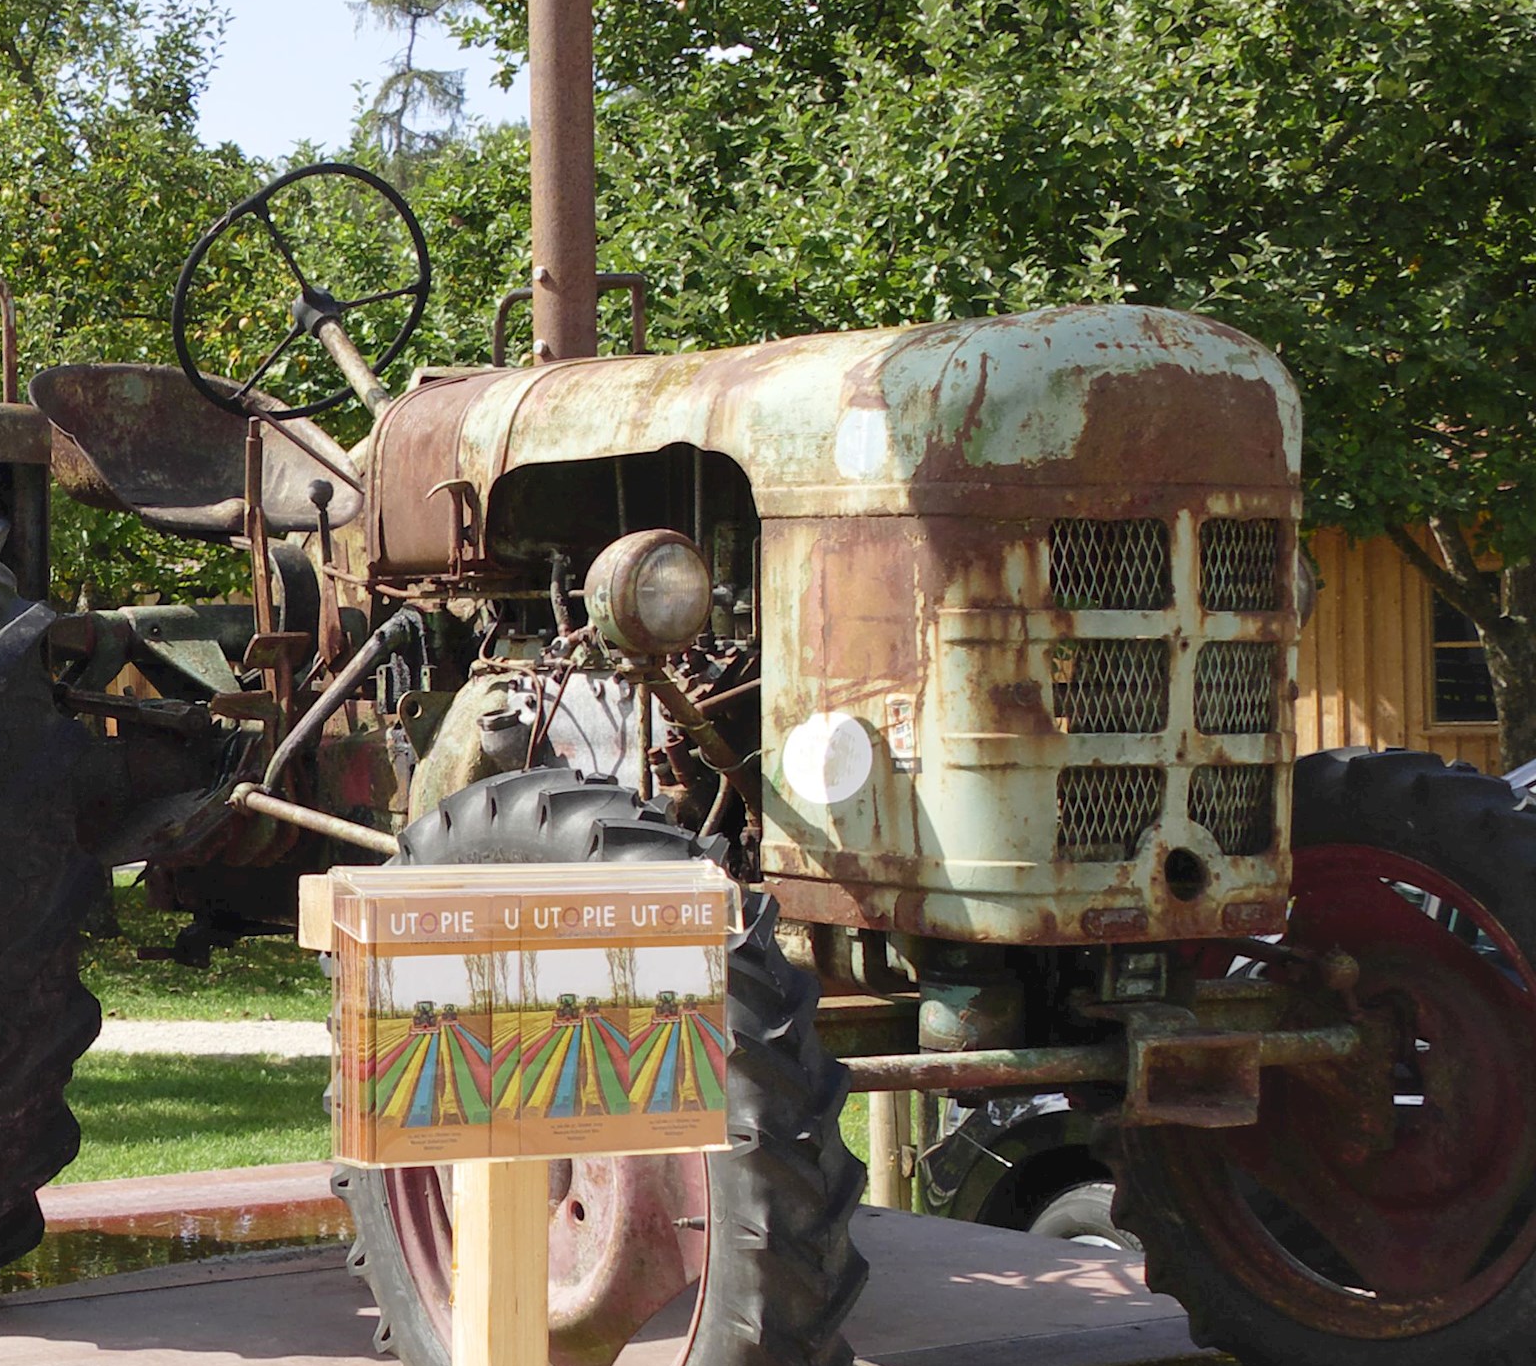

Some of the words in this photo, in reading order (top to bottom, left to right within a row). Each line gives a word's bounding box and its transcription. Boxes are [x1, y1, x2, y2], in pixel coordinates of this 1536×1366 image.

[390, 911, 474, 936] UTOPIE
[504, 908, 519, 930] U
[533, 905, 616, 930] UTOPIE
[631, 903, 713, 927] UTOPIE
